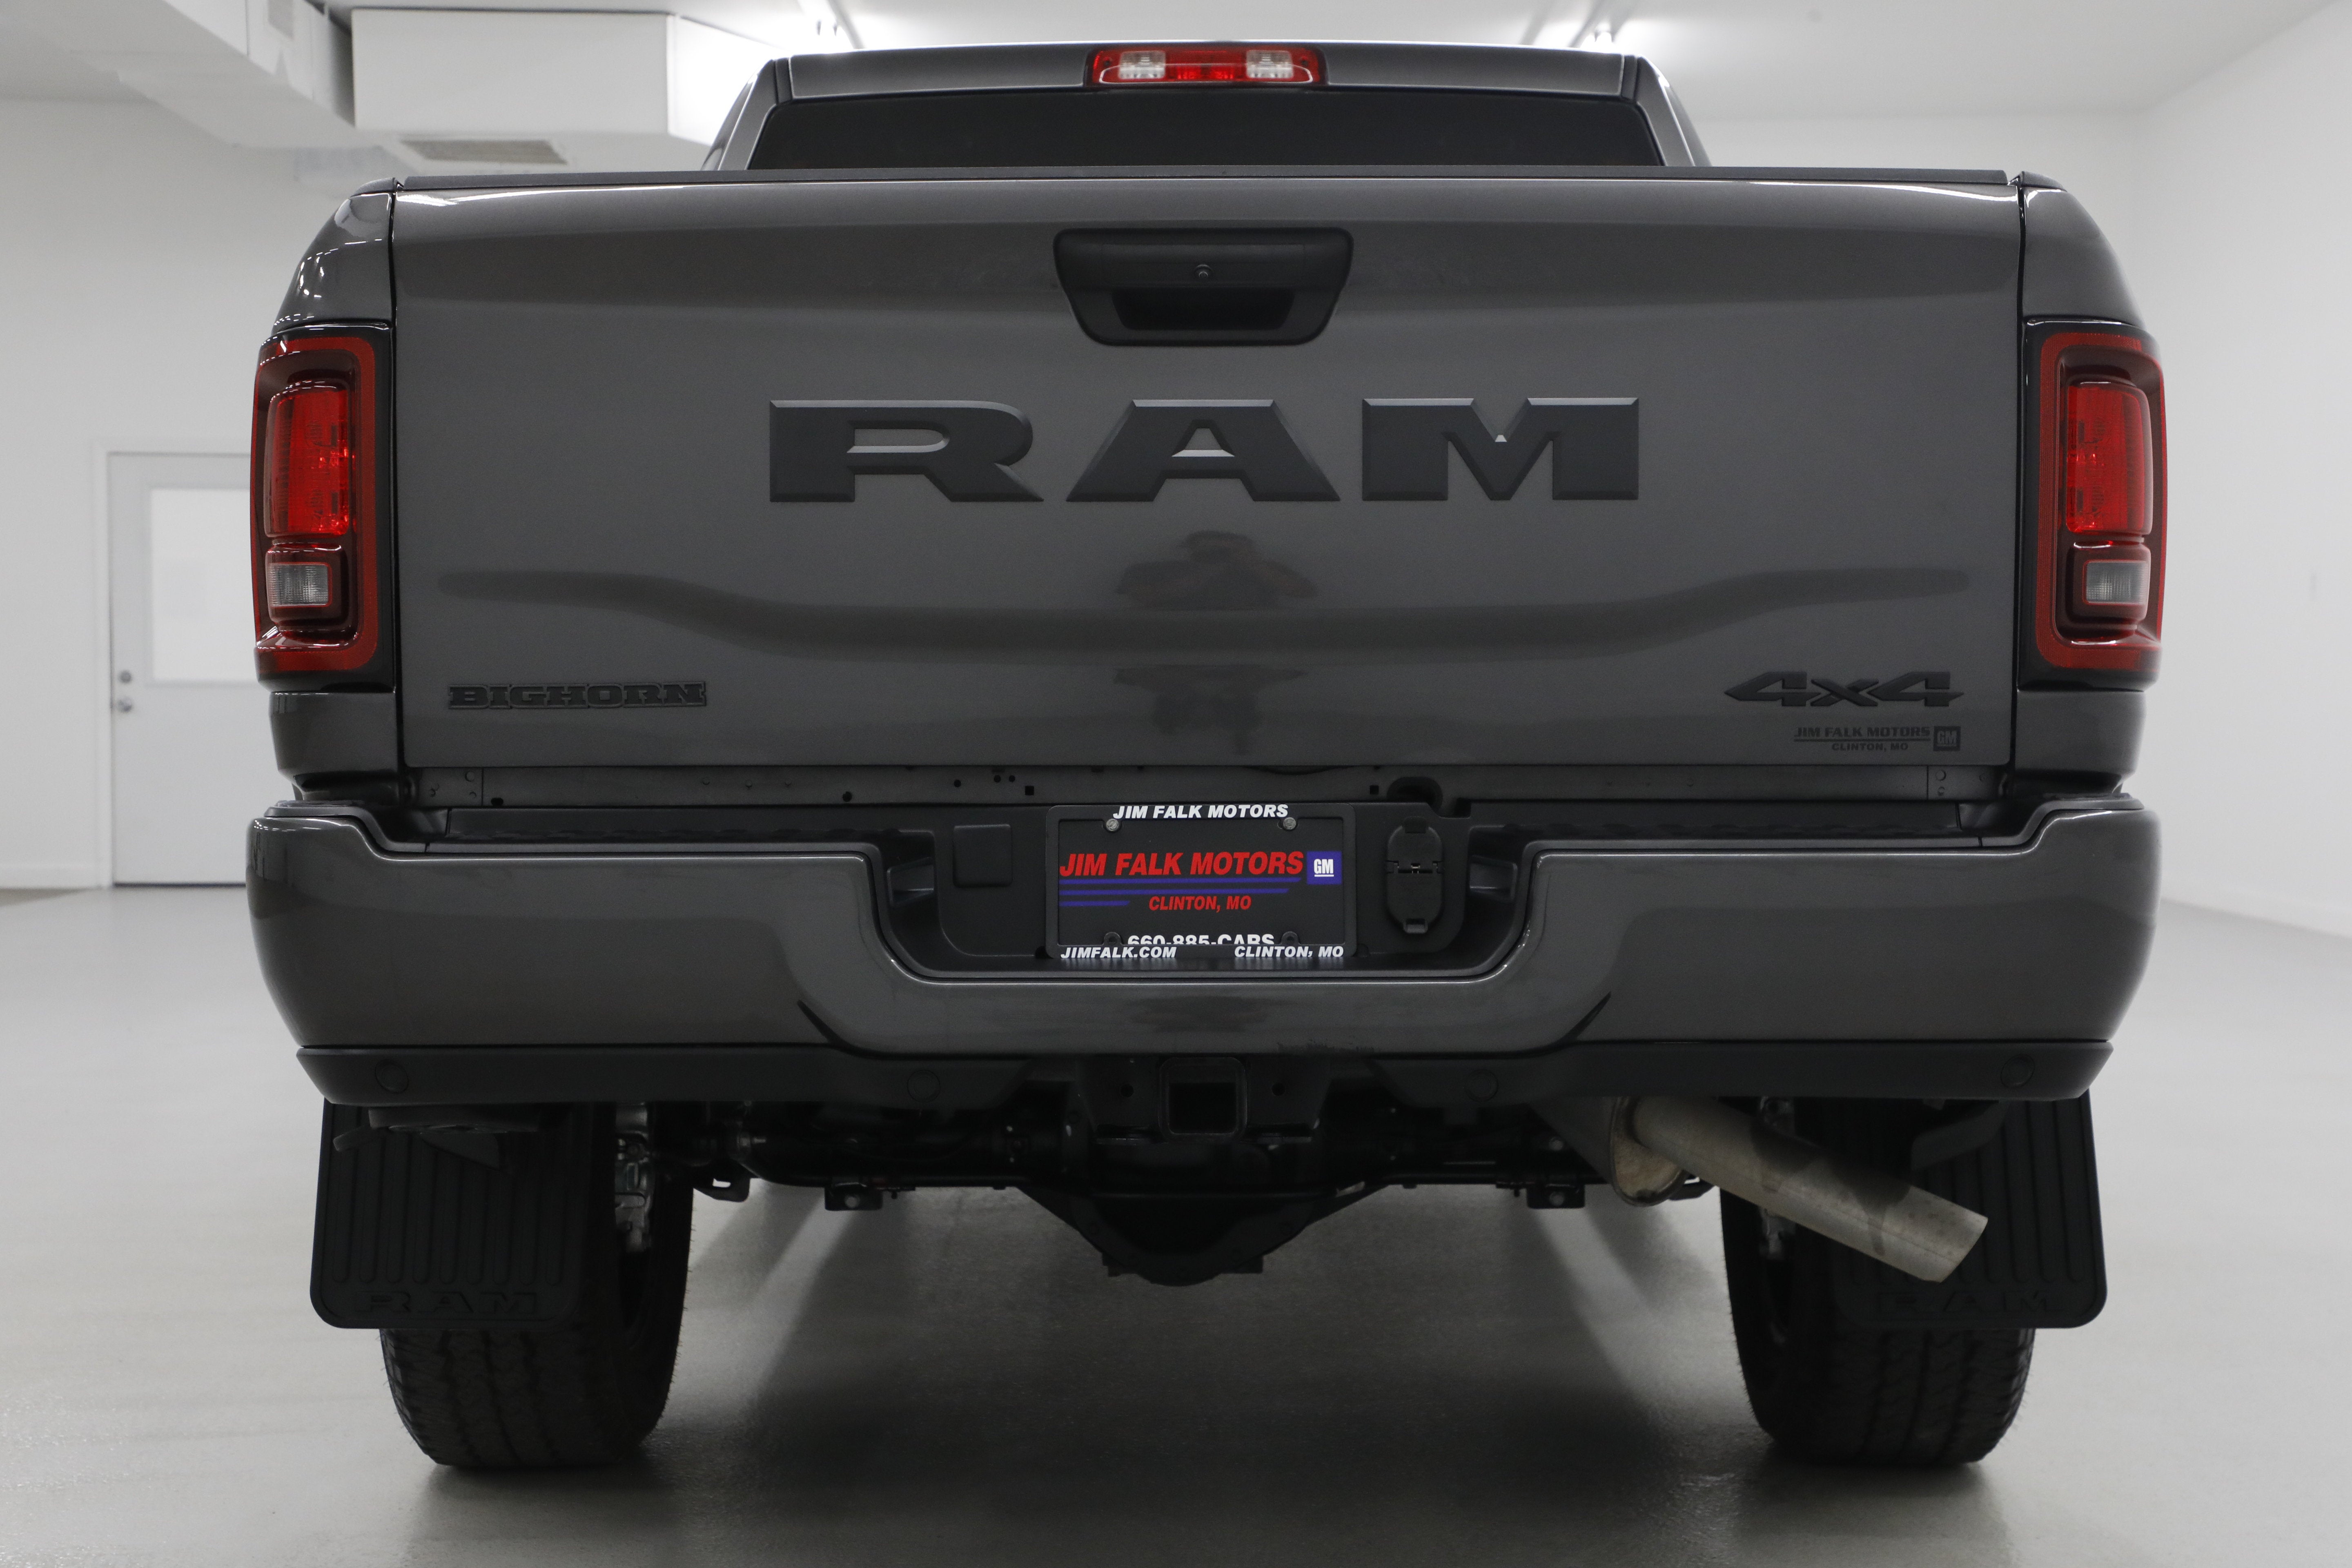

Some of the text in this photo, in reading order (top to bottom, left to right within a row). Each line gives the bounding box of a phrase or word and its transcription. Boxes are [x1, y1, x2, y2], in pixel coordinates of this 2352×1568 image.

[770, 398, 1639, 503] RAM
[448, 681, 706, 709] BIGHORN
[1797, 726, 1930, 737] JIM FALK MOTORS
[1832, 742, 1909, 752] CLINTON, MO
[1113, 804, 1288, 819] JIM FALK MOTORS
[1060, 851, 1303, 877] JIM FALK MOTORS
[1314, 859, 1334, 874] GM
[1149, 895, 1252, 912] CLINTON, MO
[1061, 947, 1176, 958] JIMFALK.COM
[1234, 946, 1343, 958] CLINTON, MO
[354, 1290, 537, 1313] RAM
